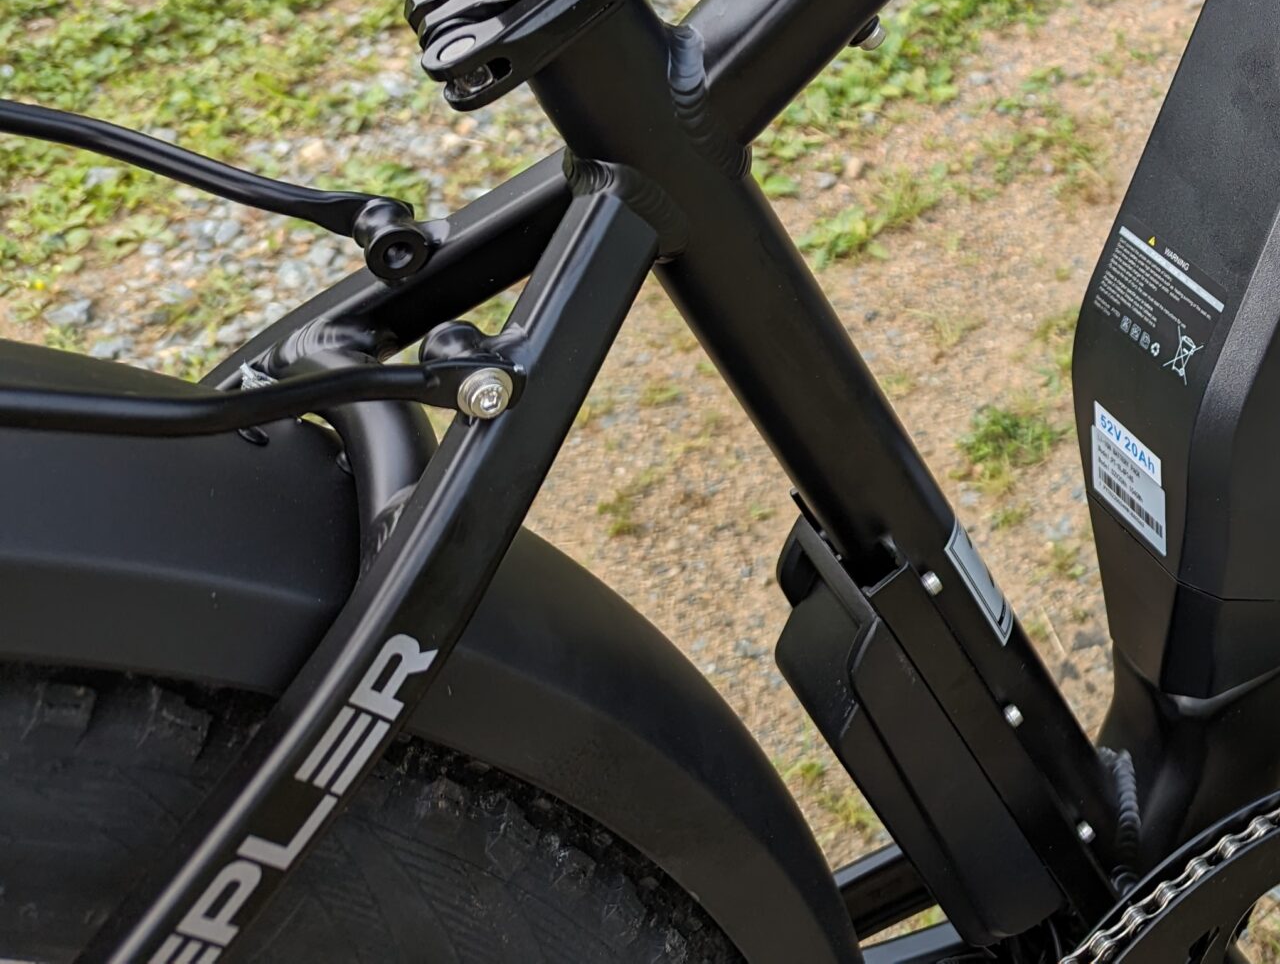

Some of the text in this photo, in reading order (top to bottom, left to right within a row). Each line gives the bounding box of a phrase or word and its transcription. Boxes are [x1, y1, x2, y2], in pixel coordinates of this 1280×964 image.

[1164, 246, 1190, 272] WARNING
[1100, 414, 1122, 442] 52V
[1124, 436, 1156, 475] 20Ah
